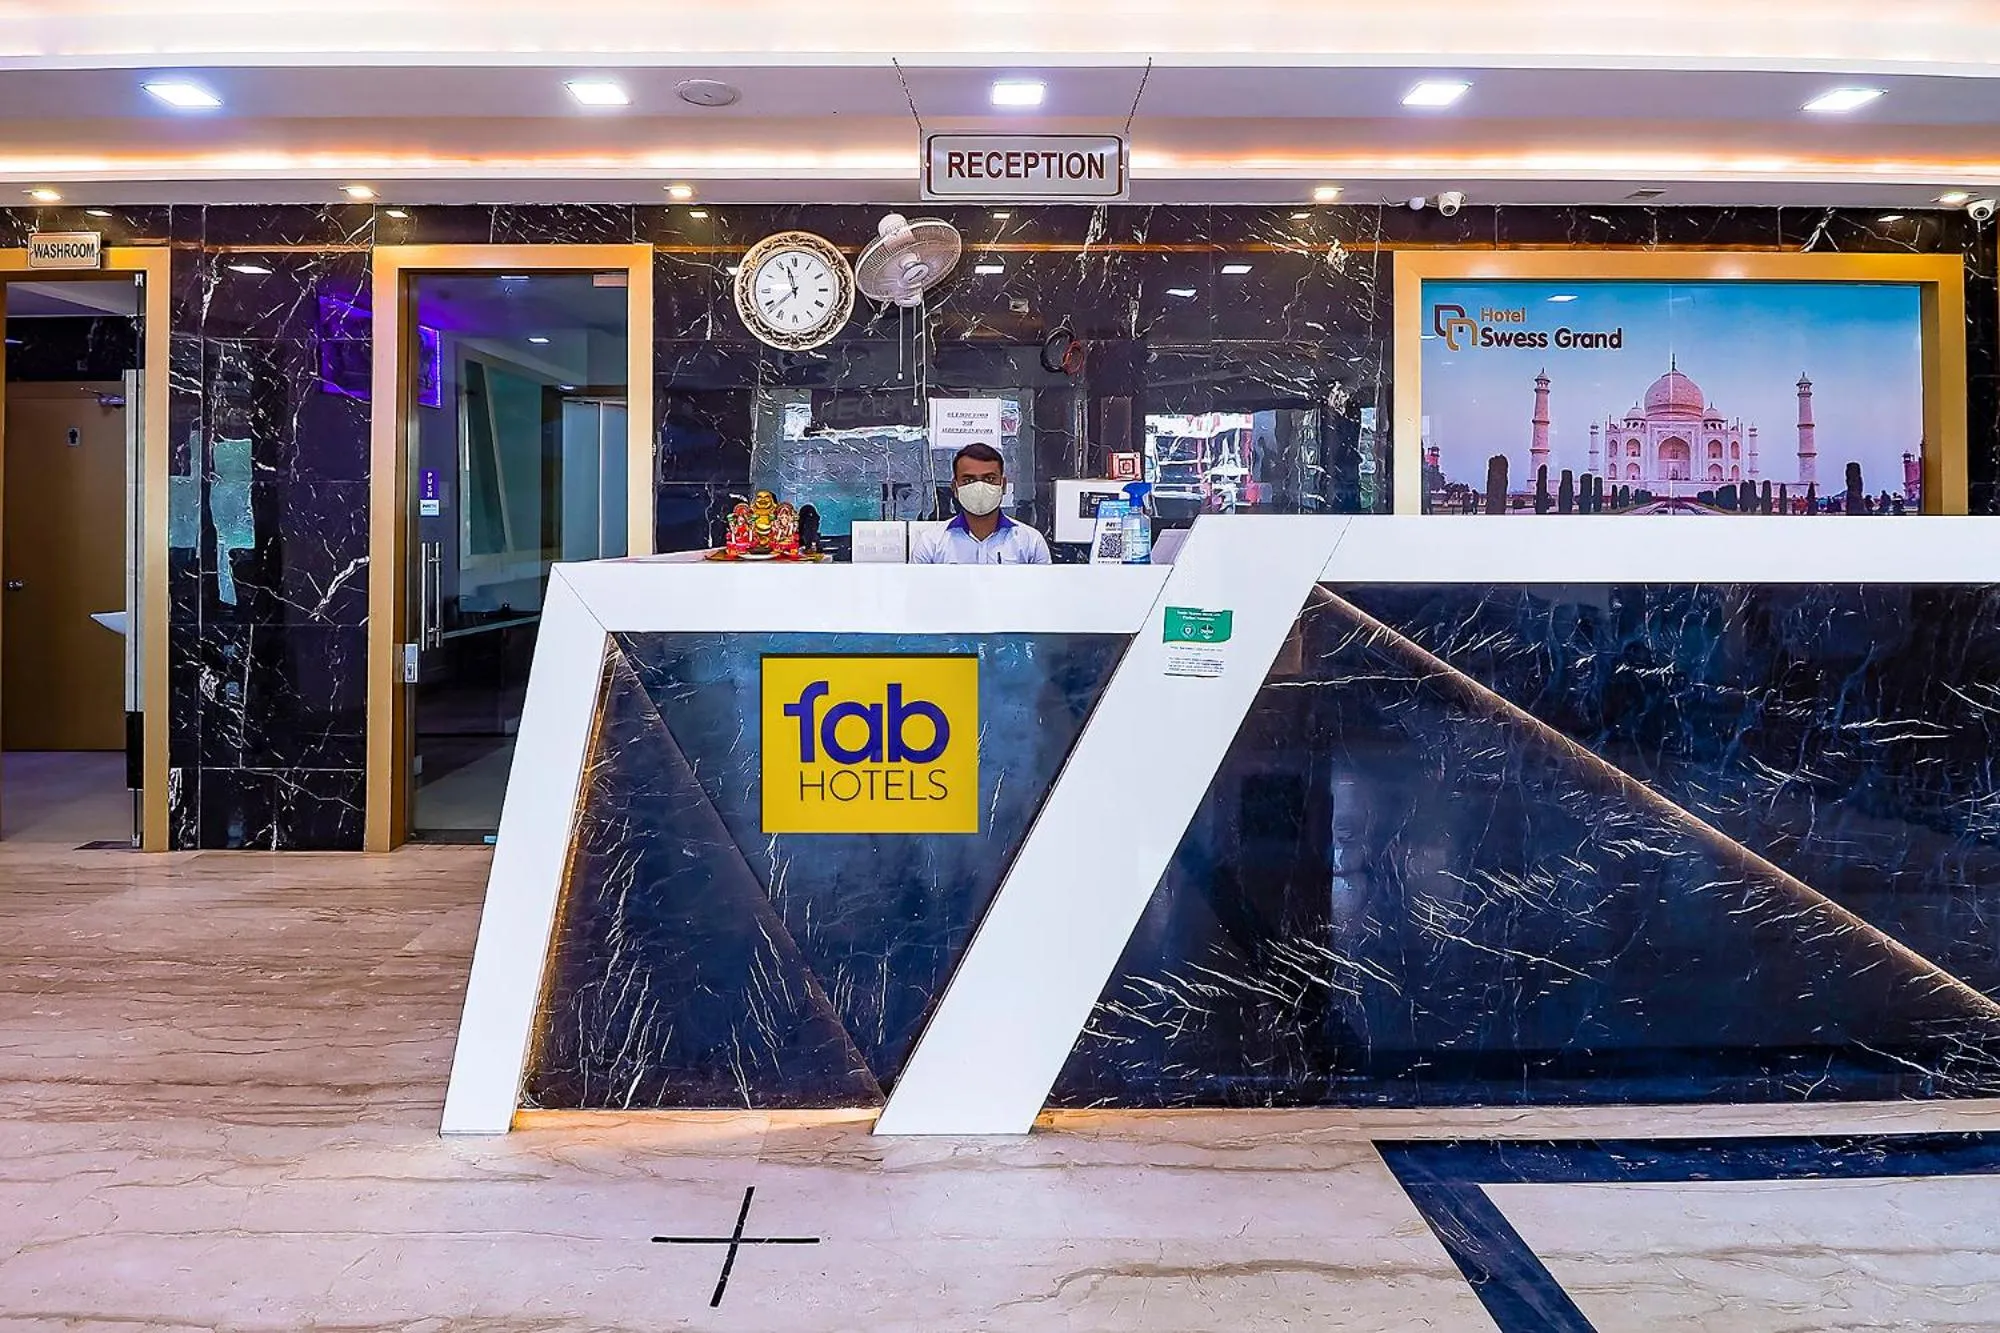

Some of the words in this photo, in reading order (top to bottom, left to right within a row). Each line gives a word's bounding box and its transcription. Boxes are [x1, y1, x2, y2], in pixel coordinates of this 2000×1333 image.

[947, 151, 1105, 179] RECEPTION
[33, 243, 95, 259] WASHROOM
[1481, 307, 1526, 323] Hotel
[1481, 327, 1548, 348] Swess
[1554, 327, 1622, 348] Grand
[783, 680, 950, 765] fab
[800, 768, 949, 801] HOTELS
